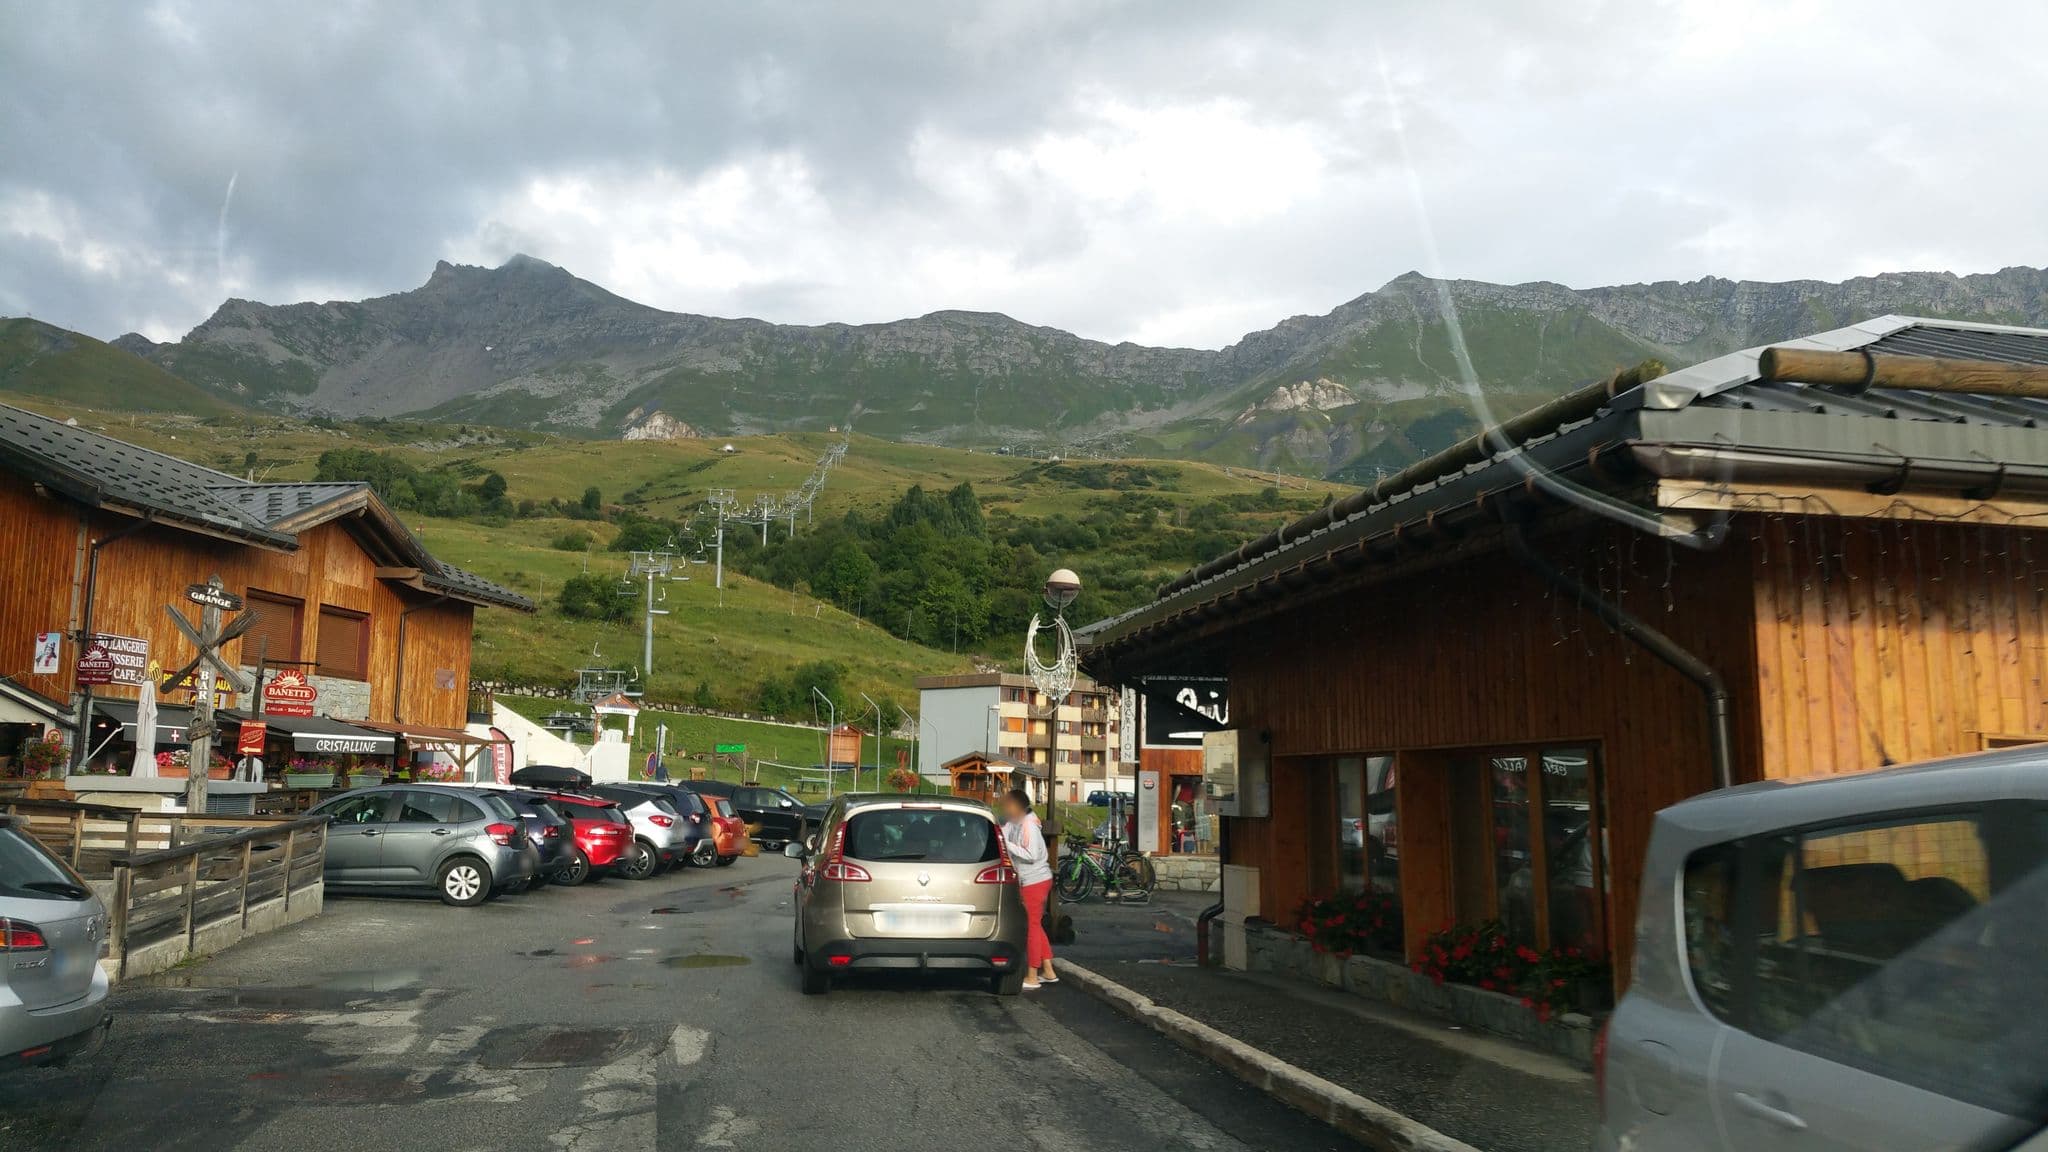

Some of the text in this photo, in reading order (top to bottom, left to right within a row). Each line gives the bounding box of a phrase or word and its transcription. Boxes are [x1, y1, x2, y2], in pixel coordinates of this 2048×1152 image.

[207, 588, 219, 597] LA
[191, 592, 232, 608] GRANGE
[79, 661, 110, 669] BANETTE
[198, 671, 210, 700] BAR
[268, 688, 311, 698] BANETTE
[316, 739, 377, 753] CRISTALLINE
